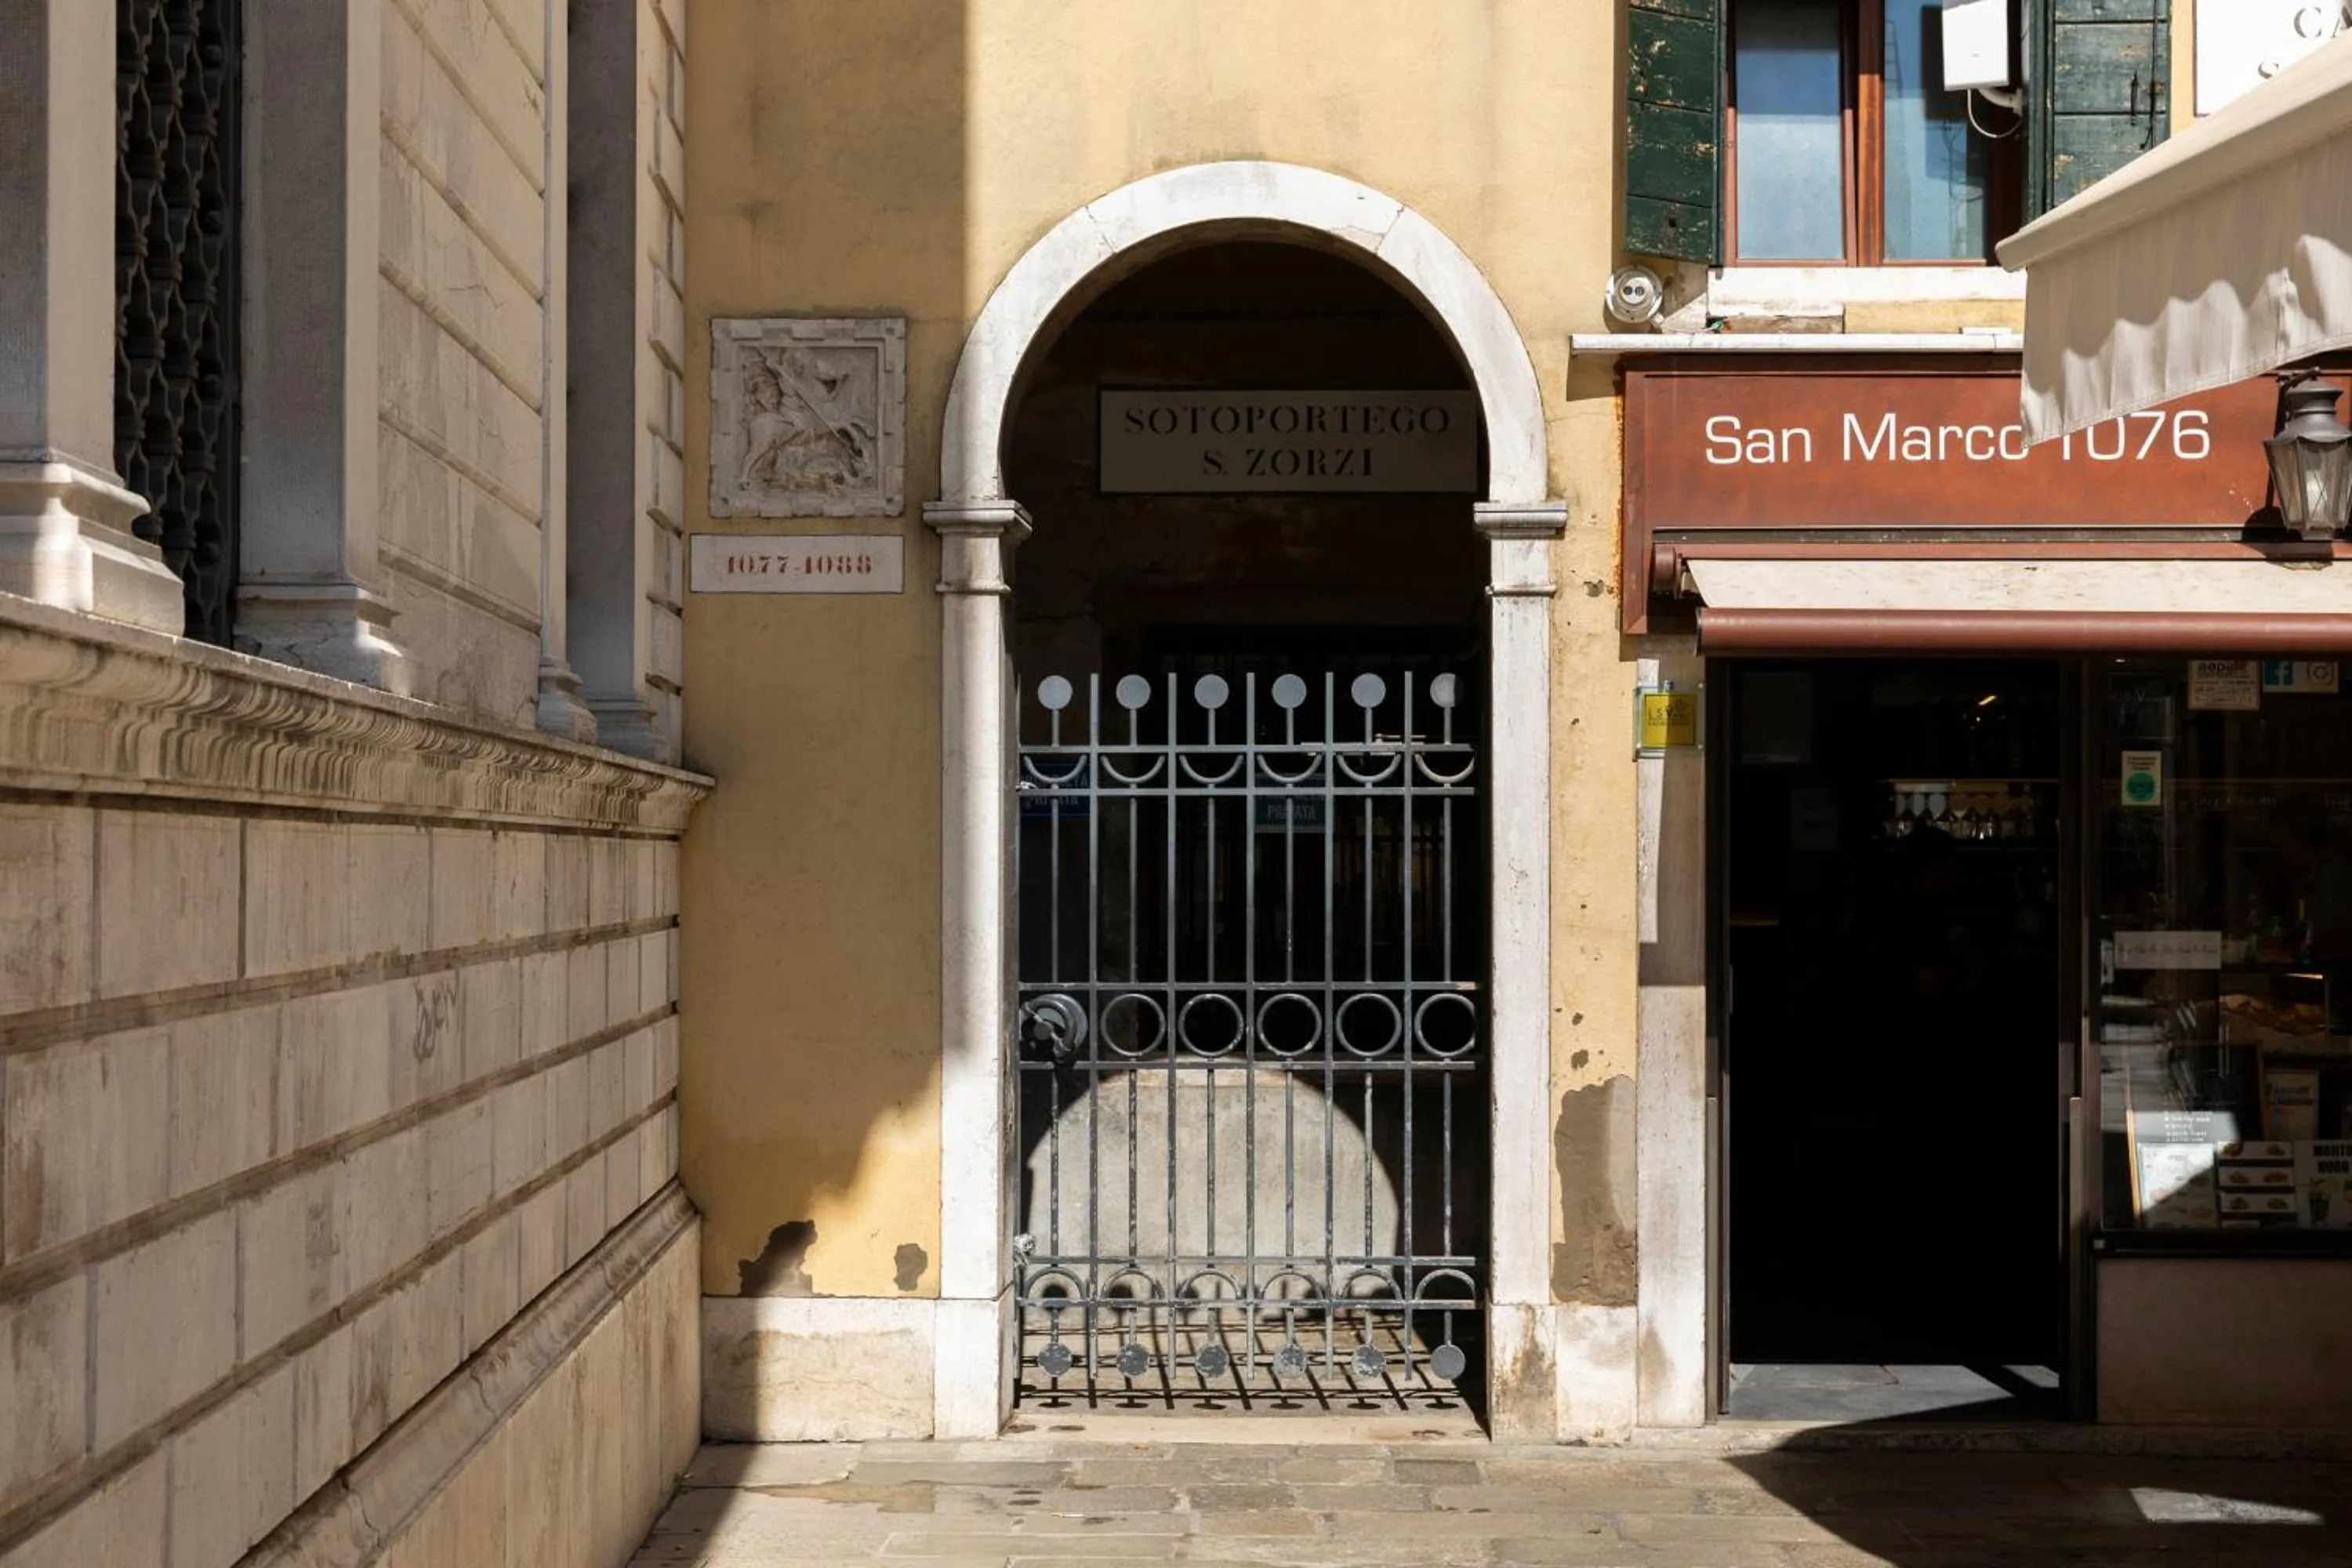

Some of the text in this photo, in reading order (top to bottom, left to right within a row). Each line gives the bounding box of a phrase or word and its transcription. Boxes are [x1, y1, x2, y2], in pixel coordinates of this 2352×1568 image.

[1123, 405, 1450, 434] SOTOPORTEGO
[1705, 415, 1812, 465] San
[1843, 412, 2031, 461] Marco
[1203, 448, 1374, 477] S. ZORZI
